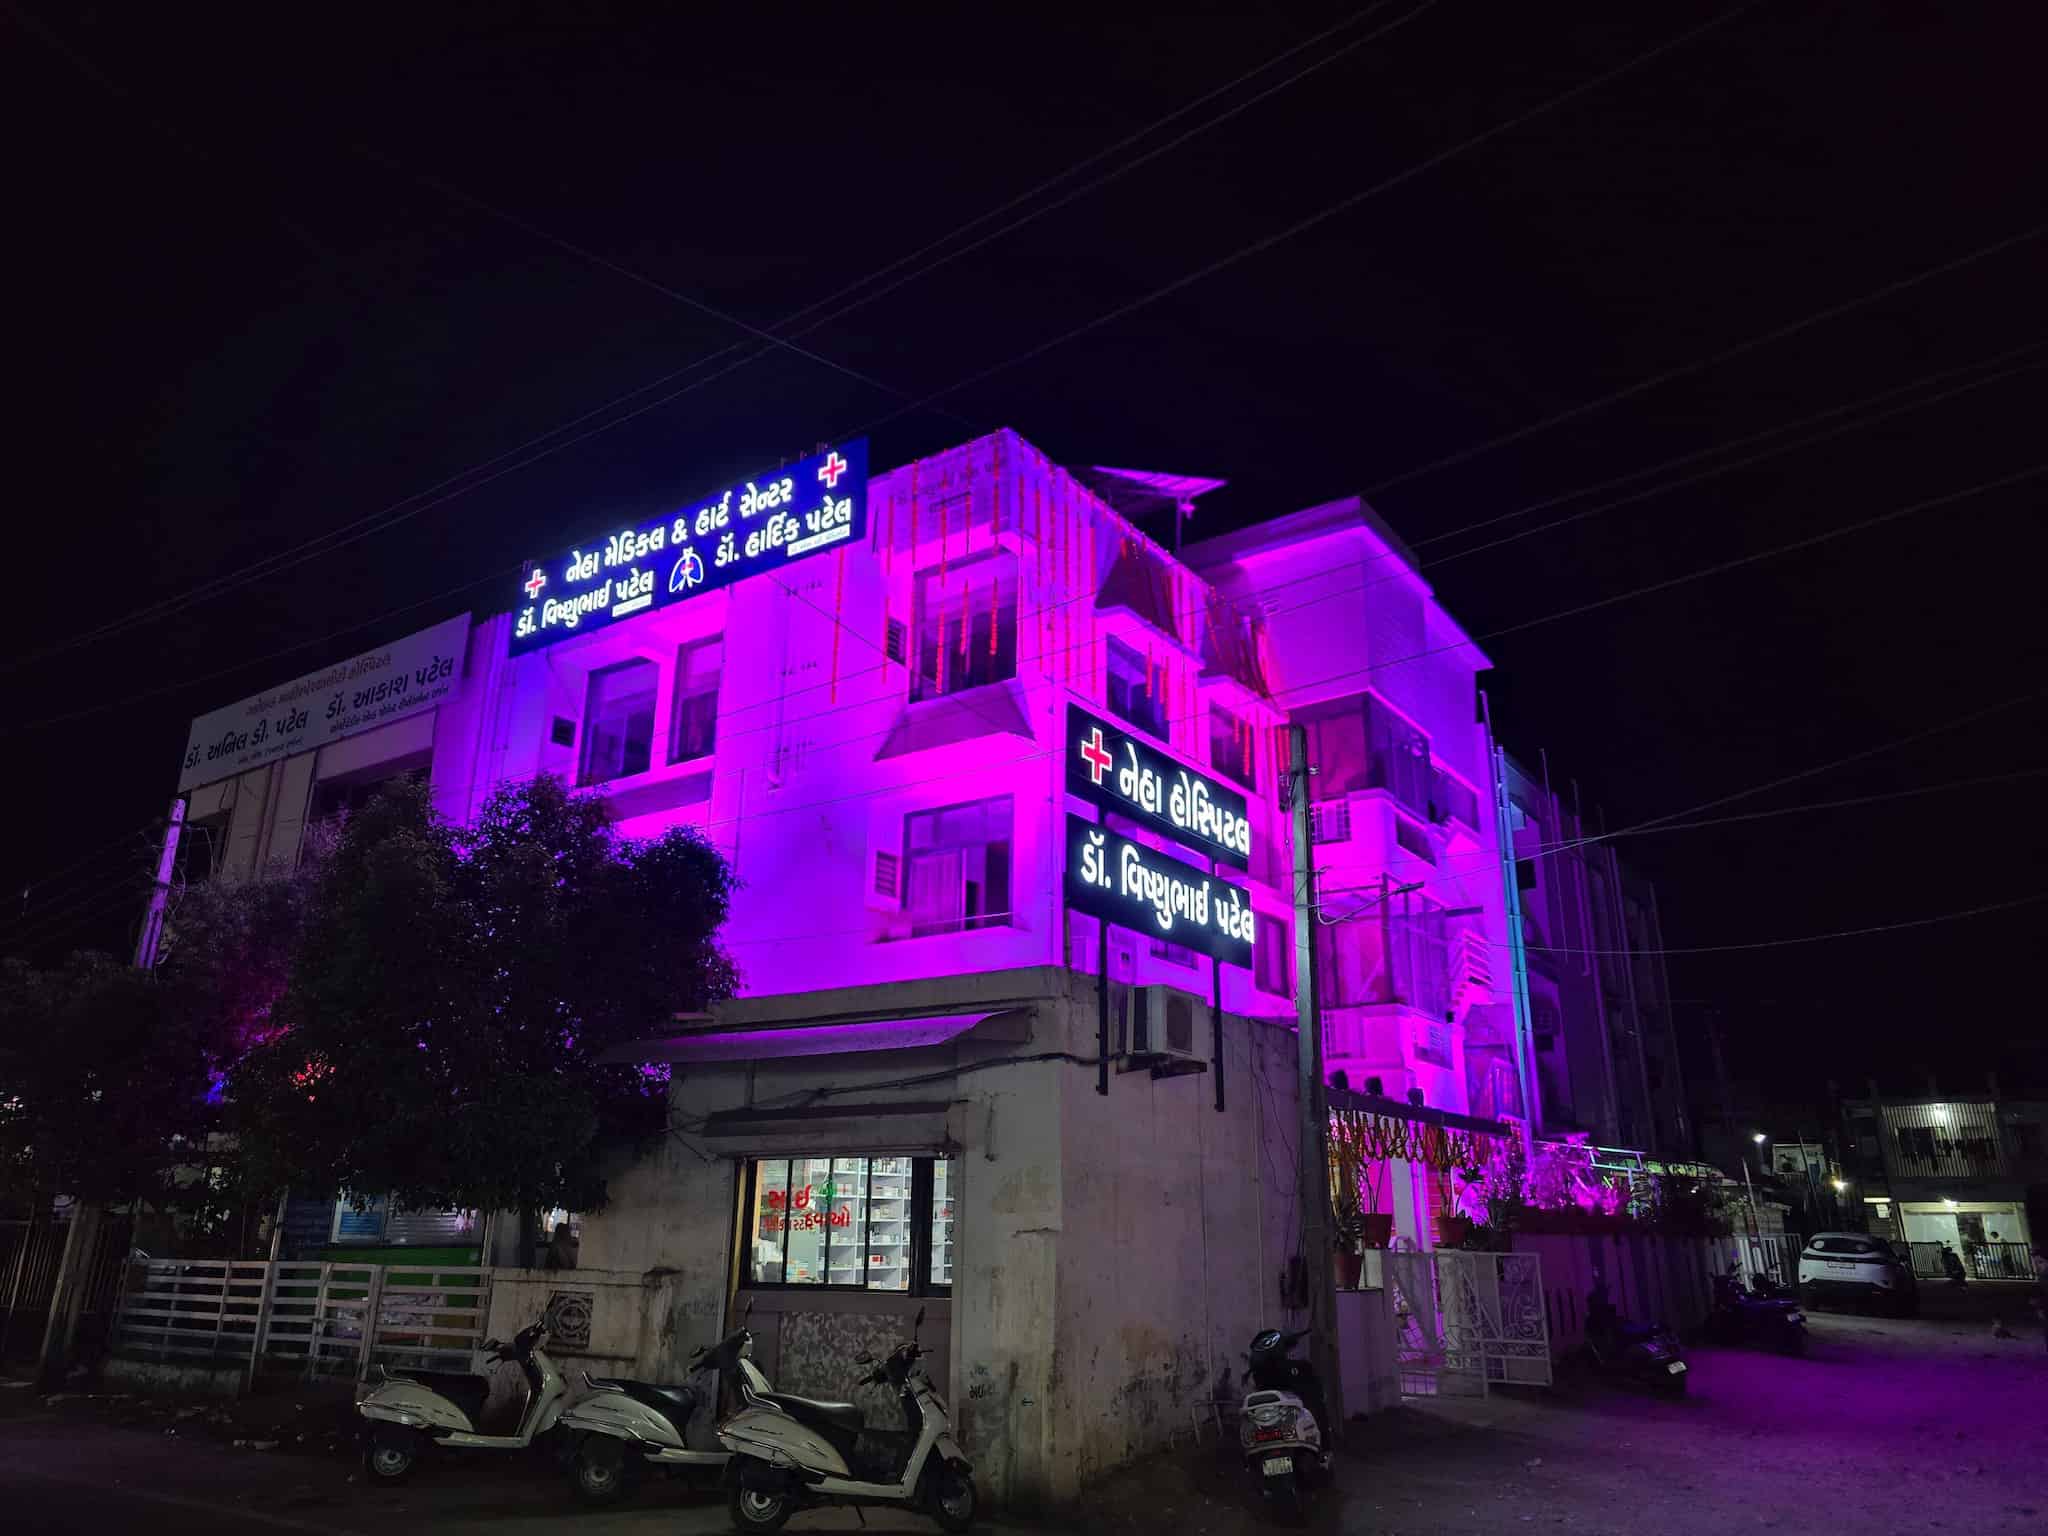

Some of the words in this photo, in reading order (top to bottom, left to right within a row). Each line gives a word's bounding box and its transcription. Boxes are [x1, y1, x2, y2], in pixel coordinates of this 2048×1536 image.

[566, 550, 600, 582] નેહા
[605, 526, 665, 567] મેડિકલ
[671, 518, 688, 544] &
[695, 491, 732, 536] હાર્ટ
[739, 477, 793, 518] સેન્ટર
[745, 511, 801, 557] હાર્દિક
[806, 495, 852, 531] પટેલ
[616, 568, 654, 601] પટેલ
[353, 674, 409, 709] આકાશ
[416, 655, 454, 686] પટેલ
[207, 730, 248, 761] અનિલ
[276, 708, 310, 736] પટેલ
[1119, 743, 1162, 814] નેહા
[1169, 771, 1251, 856] હોસ્પિટલ
[1216, 889, 1255, 944] પટેલ
